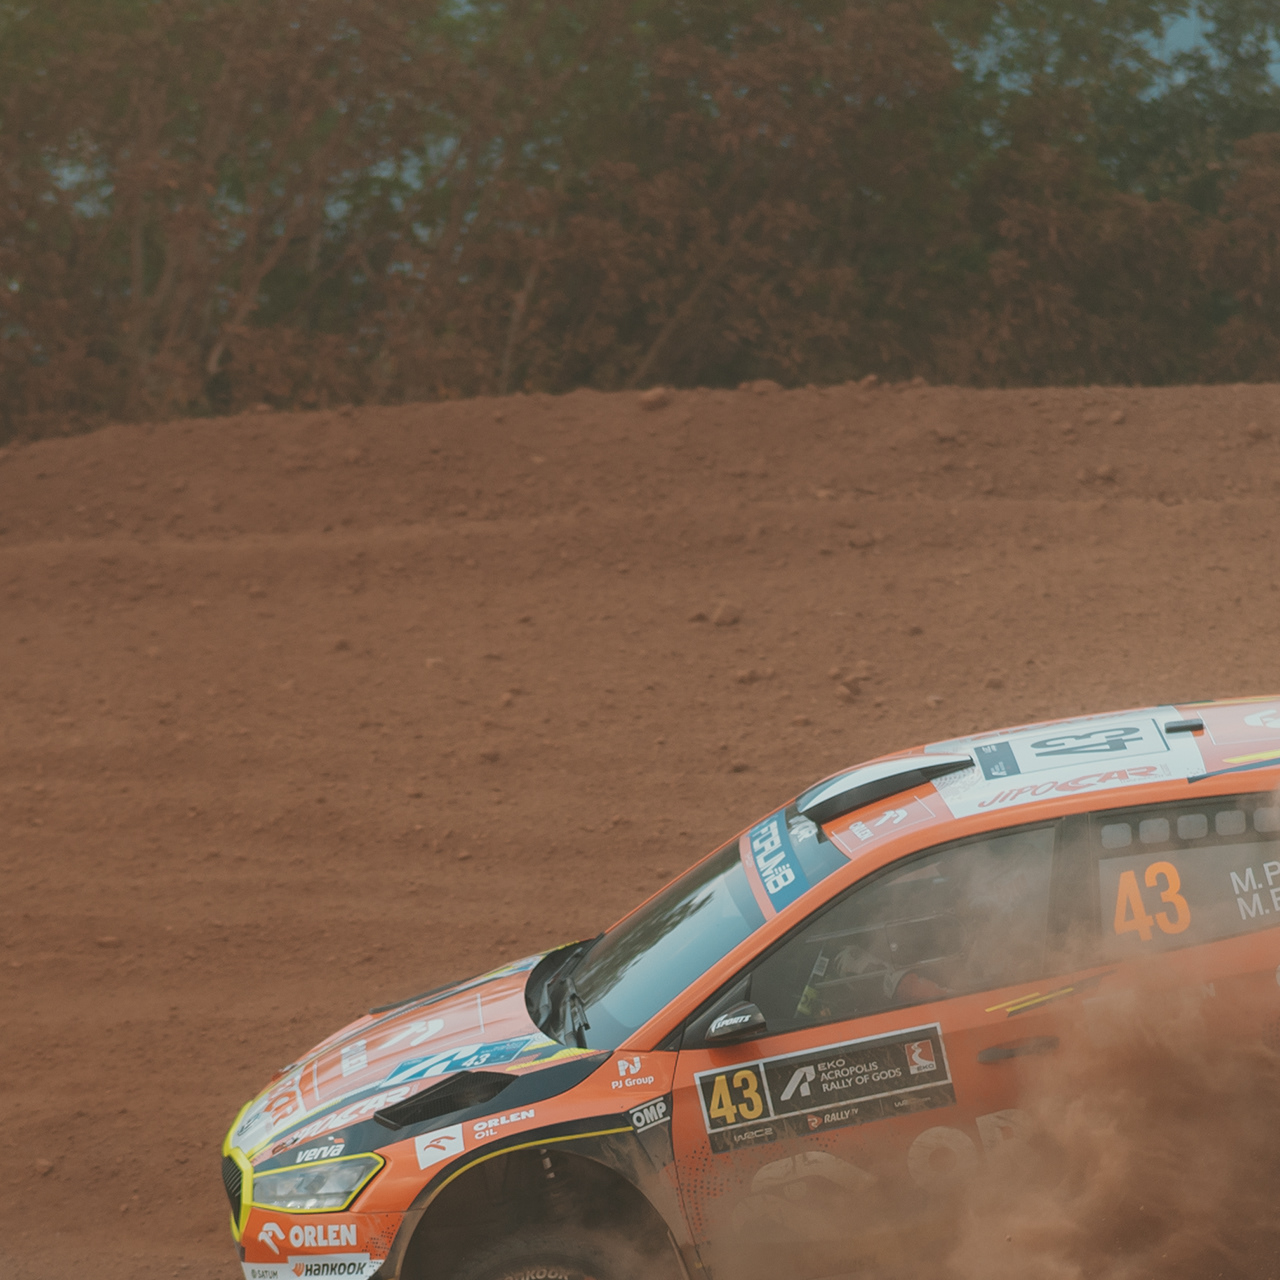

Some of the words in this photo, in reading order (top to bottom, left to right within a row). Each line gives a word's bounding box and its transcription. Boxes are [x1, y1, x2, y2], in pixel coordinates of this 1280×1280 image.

[1030, 726, 1143, 758] 43
[977, 765, 1158, 808] JIPOCAR
[1230, 872, 1264, 895] M.
[1114, 861, 1191, 942] 43
[1236, 895, 1270, 920] M.
[462, 1052, 490, 1069] 43
[818, 1058, 846, 1072] EKO
[820, 1061, 879, 1082] ACROPOLIS
[916, 1063, 935, 1072] EKO
[611, 1080, 623, 1090] PJ
[624, 1075, 655, 1088] Group
[822, 1077, 854, 1092] RALLY
[855, 1074, 870, 1086] OF
[871, 1068, 902, 1083] GODS
[709, 1070, 764, 1125] 43
[473, 1109, 535, 1132] ORLEN
[632, 1101, 667, 1128] OMP
[823, 1109, 850, 1124] RALLY
[474, 1128, 498, 1140] OIL
[296, 1144, 345, 1163] verva
[289, 1224, 357, 1248] ORLEN
